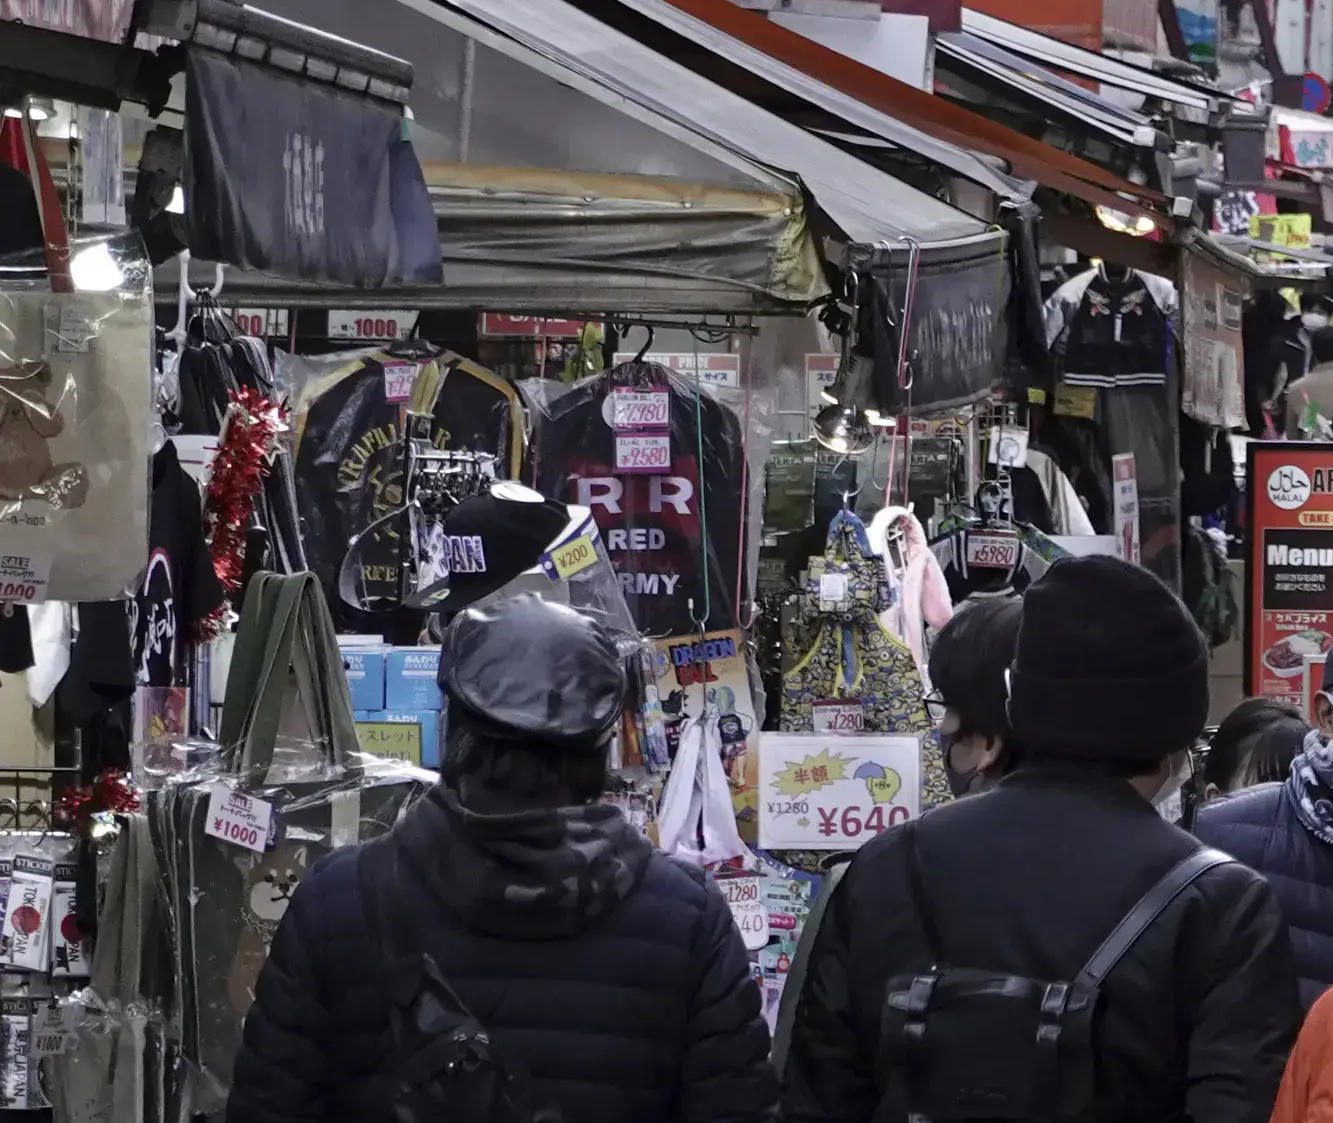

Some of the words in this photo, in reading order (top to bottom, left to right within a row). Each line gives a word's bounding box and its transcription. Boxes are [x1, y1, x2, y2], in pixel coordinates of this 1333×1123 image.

[353, 318, 398, 338] 1000
[576, 475, 624, 515] R
[648, 475, 695, 515] R
[1273, 493, 1305, 503] HALAL
[1302, 513, 1329, 525] TAKE
[608, 527, 666, 552] RED
[1, 556, 31, 569] SALE
[558, 544, 589, 569] ¥200
[617, 572, 682, 597] RMY
[357, 728, 418, 742] スレット
[793, 764, 830, 785] 半額
[227, 792, 255, 811] SALE
[766, 800, 810, 816] ¥1280
[212, 815, 258, 847] ¥1000
[816, 804, 911, 838] ¥640
